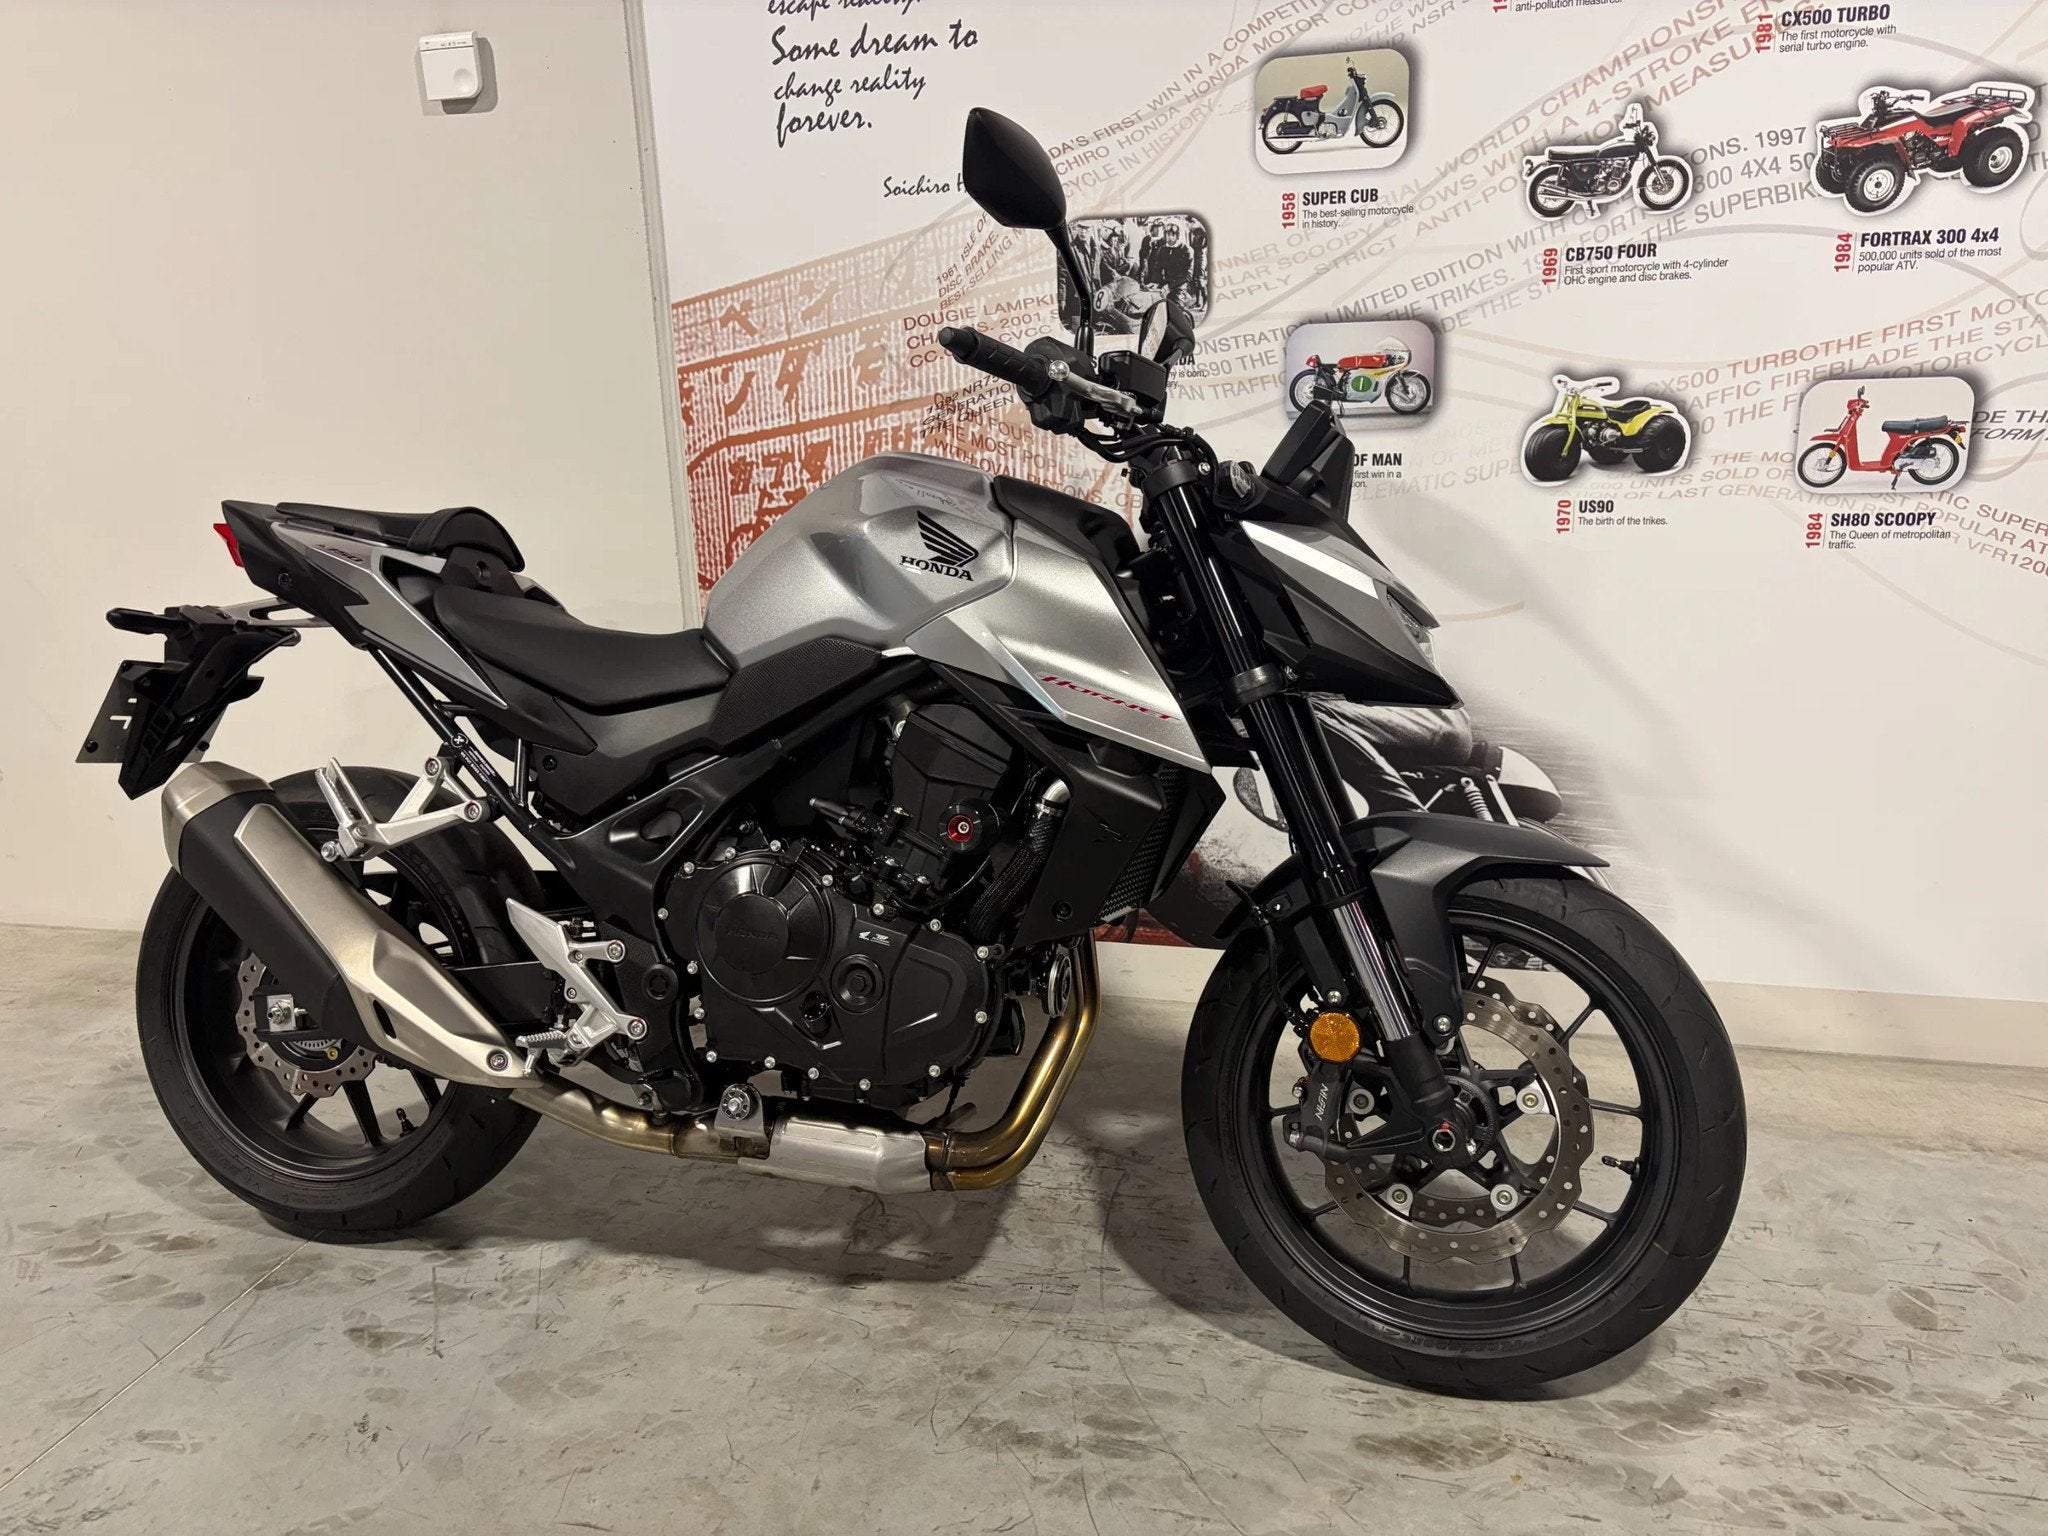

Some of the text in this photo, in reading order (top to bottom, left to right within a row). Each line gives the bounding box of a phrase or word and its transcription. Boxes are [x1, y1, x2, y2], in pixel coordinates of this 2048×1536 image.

[1781, 9, 1832, 27] CX500
[1837, 4, 1891, 23] TURBO
[771, 19, 978, 65] Some dream to
[1756, 13, 1773, 53] 1981
[1779, 38, 1869, 53] serial turbo engine.
[1780, 24, 1897, 42] The first motorcycle with
[774, 63, 926, 107] change reality
[1055, 145, 1110, 176] CHIRO
[1116, 105, 1181, 150] HONDA
[1184, 55, 1249, 104] HONDA
[1252, 12, 1329, 55] MOTOR
[1483, 127, 1552, 178] WITH
[1555, 115, 1580, 136] A
[1586, 16, 1735, 117] 4-STROKE
[1048, 52, 1222, 159] DA'S FIRST WIN IN A
[776, 102, 872, 148] forever.
[1062, 97, 1216, 198] CYCLE IN HISTORY
[1689, 126, 1807, 166] ONS. 1997
[883, 175, 951, 197] Soichiro
[1212, 242, 1278, 274] INNER
[1436, 115, 1531, 178] WORLD
[1302, 190, 1346, 206] SUPER
[1350, 188, 1379, 204] CUB
[1282, 192, 1296, 229] 1958
[1302, 204, 1414, 219] The best-selling motorcycle
[1302, 219, 1341, 230] in history.
[1426, 268, 1515, 311] TRIKES.
[1740, 155, 1788, 179] 4X4
[1641, 210, 1688, 244] THE
[1861, 227, 1999, 248] FORTRAX 300 4x4
[936, 264, 958, 285] 1961
[961, 232, 976, 261] ISLE
[938, 230, 1000, 298] DISC BRAKE.
[1410, 244, 1504, 292] EDITION
[1507, 216, 1567, 252] WITH
[1565, 245, 1613, 262] CB750
[1617, 243, 1657, 259] FOUR
[1834, 232, 1853, 272] 1984
[1858, 246, 2002, 262] 500,000 units sold of the most
[940, 235, 1013, 310] BEST-SELLING
[1215, 234, 1400, 304] APPLY STRICT
[1542, 247, 1558, 285] 1969
[1563, 270, 1692, 286] OHC engine and disc brakes.
[1564, 258, 1729, 277] First sport motorcycle with 4-cylinder
[1857, 260, 1918, 274] popular ATV.
[903, 305, 978, 331] DOUGIE
[1475, 290, 1522, 320] THE
[1000, 312, 1042, 330] 2001
[1882, 310, 1961, 344] FIRST
[998, 325, 1053, 344] CVCC
[1236, 349, 1279, 371] THE
[1686, 380, 1761, 411] AFFIC
[1770, 342, 1919, 391] FIREBLADE
[1928, 327, 1984, 351] THE
[958, 395, 1014, 423] QUEEN
[1723, 399, 1775, 427] THE
[988, 417, 1034, 442] FOUR
[971, 431, 1018, 459] MOST
[1712, 451, 1757, 465] THE
[1372, 453, 1402, 466] MAN
[1354, 470, 1369, 479] first
[1370, 470, 1385, 479] win
[1386, 470, 1394, 478] in
[1628, 473, 1693, 490] UNITS
[1700, 467, 1759, 482] SOLD
[1578, 500, 1615, 513] US90
[1657, 486, 1710, 500] LAST
[1718, 484, 1855, 510] GENERATION
[1556, 500, 1571, 534] 1970
[1577, 516, 1668, 526] The birth of the trikes.
[1805, 512, 1823, 548] 1984
[1830, 512, 1937, 527] SH80 SCOOPY
[1828, 540, 1857, 549] traffic.
[1829, 530, 1847, 539] The
[1848, 530, 1879, 540] Queen
[1881, 529, 1892, 539] of
[1892, 529, 1951, 541] metropolitan
[899, 555, 974, 581] HONDA
